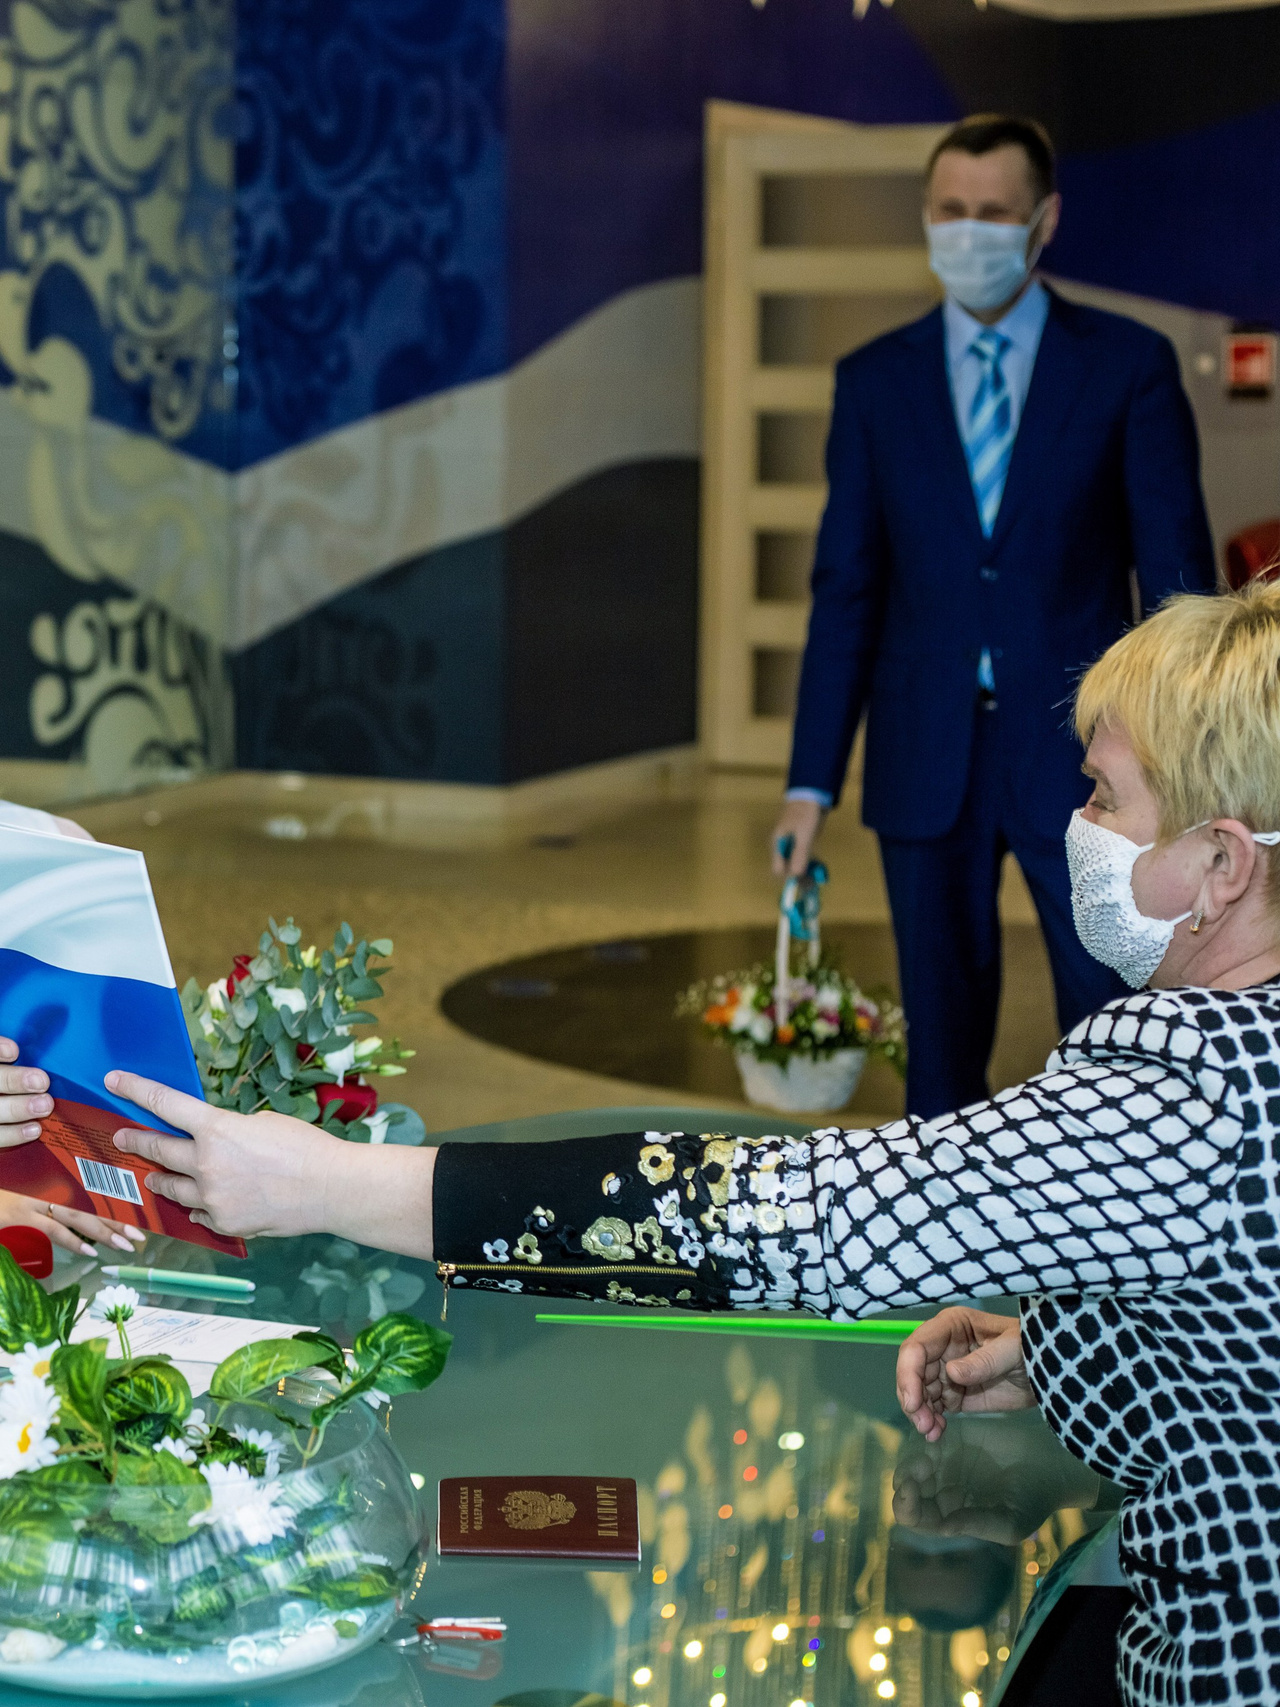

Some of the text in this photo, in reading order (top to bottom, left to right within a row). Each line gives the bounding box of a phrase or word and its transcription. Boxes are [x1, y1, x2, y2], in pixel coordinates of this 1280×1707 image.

[459, 1486, 469, 1534] РОССИЙСКАЯ
[473, 1489, 483, 1531] ФЕДЕРАЦИЯ
[596, 1485, 618, 1537] ПАСПОРТ
